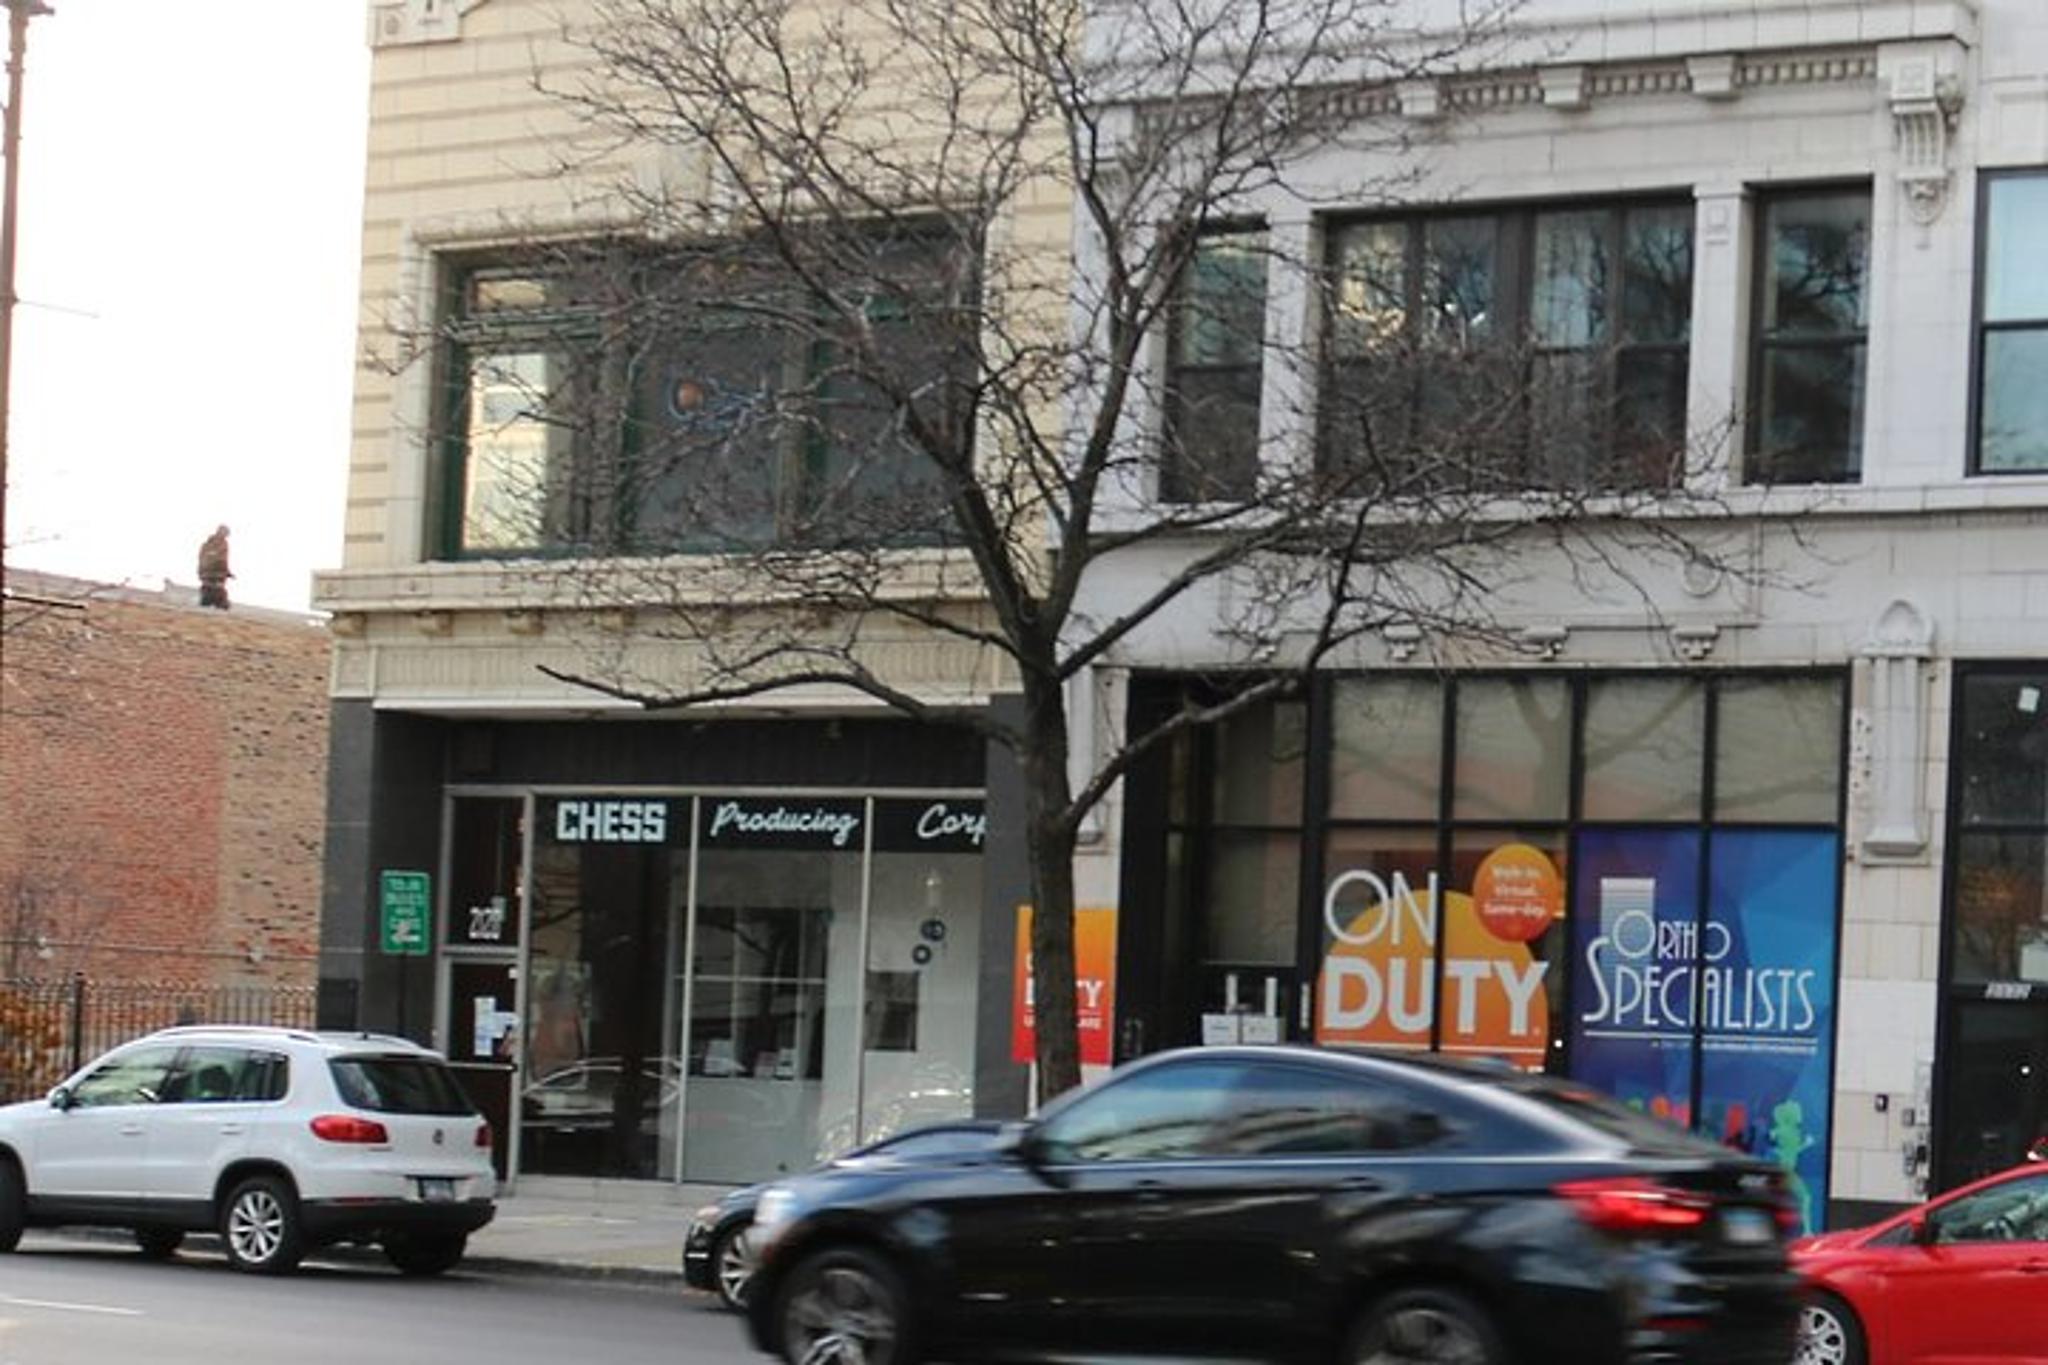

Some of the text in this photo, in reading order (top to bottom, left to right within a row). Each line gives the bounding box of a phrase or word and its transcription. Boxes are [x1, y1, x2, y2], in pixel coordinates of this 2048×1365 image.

[556, 802, 667, 842] CHESS
[709, 801, 859, 846] Producing
[1324, 869, 1438, 946] ON
[1613, 910, 1731, 961] ORTHO
[1582, 937, 1816, 1031] SPECIALISTS
